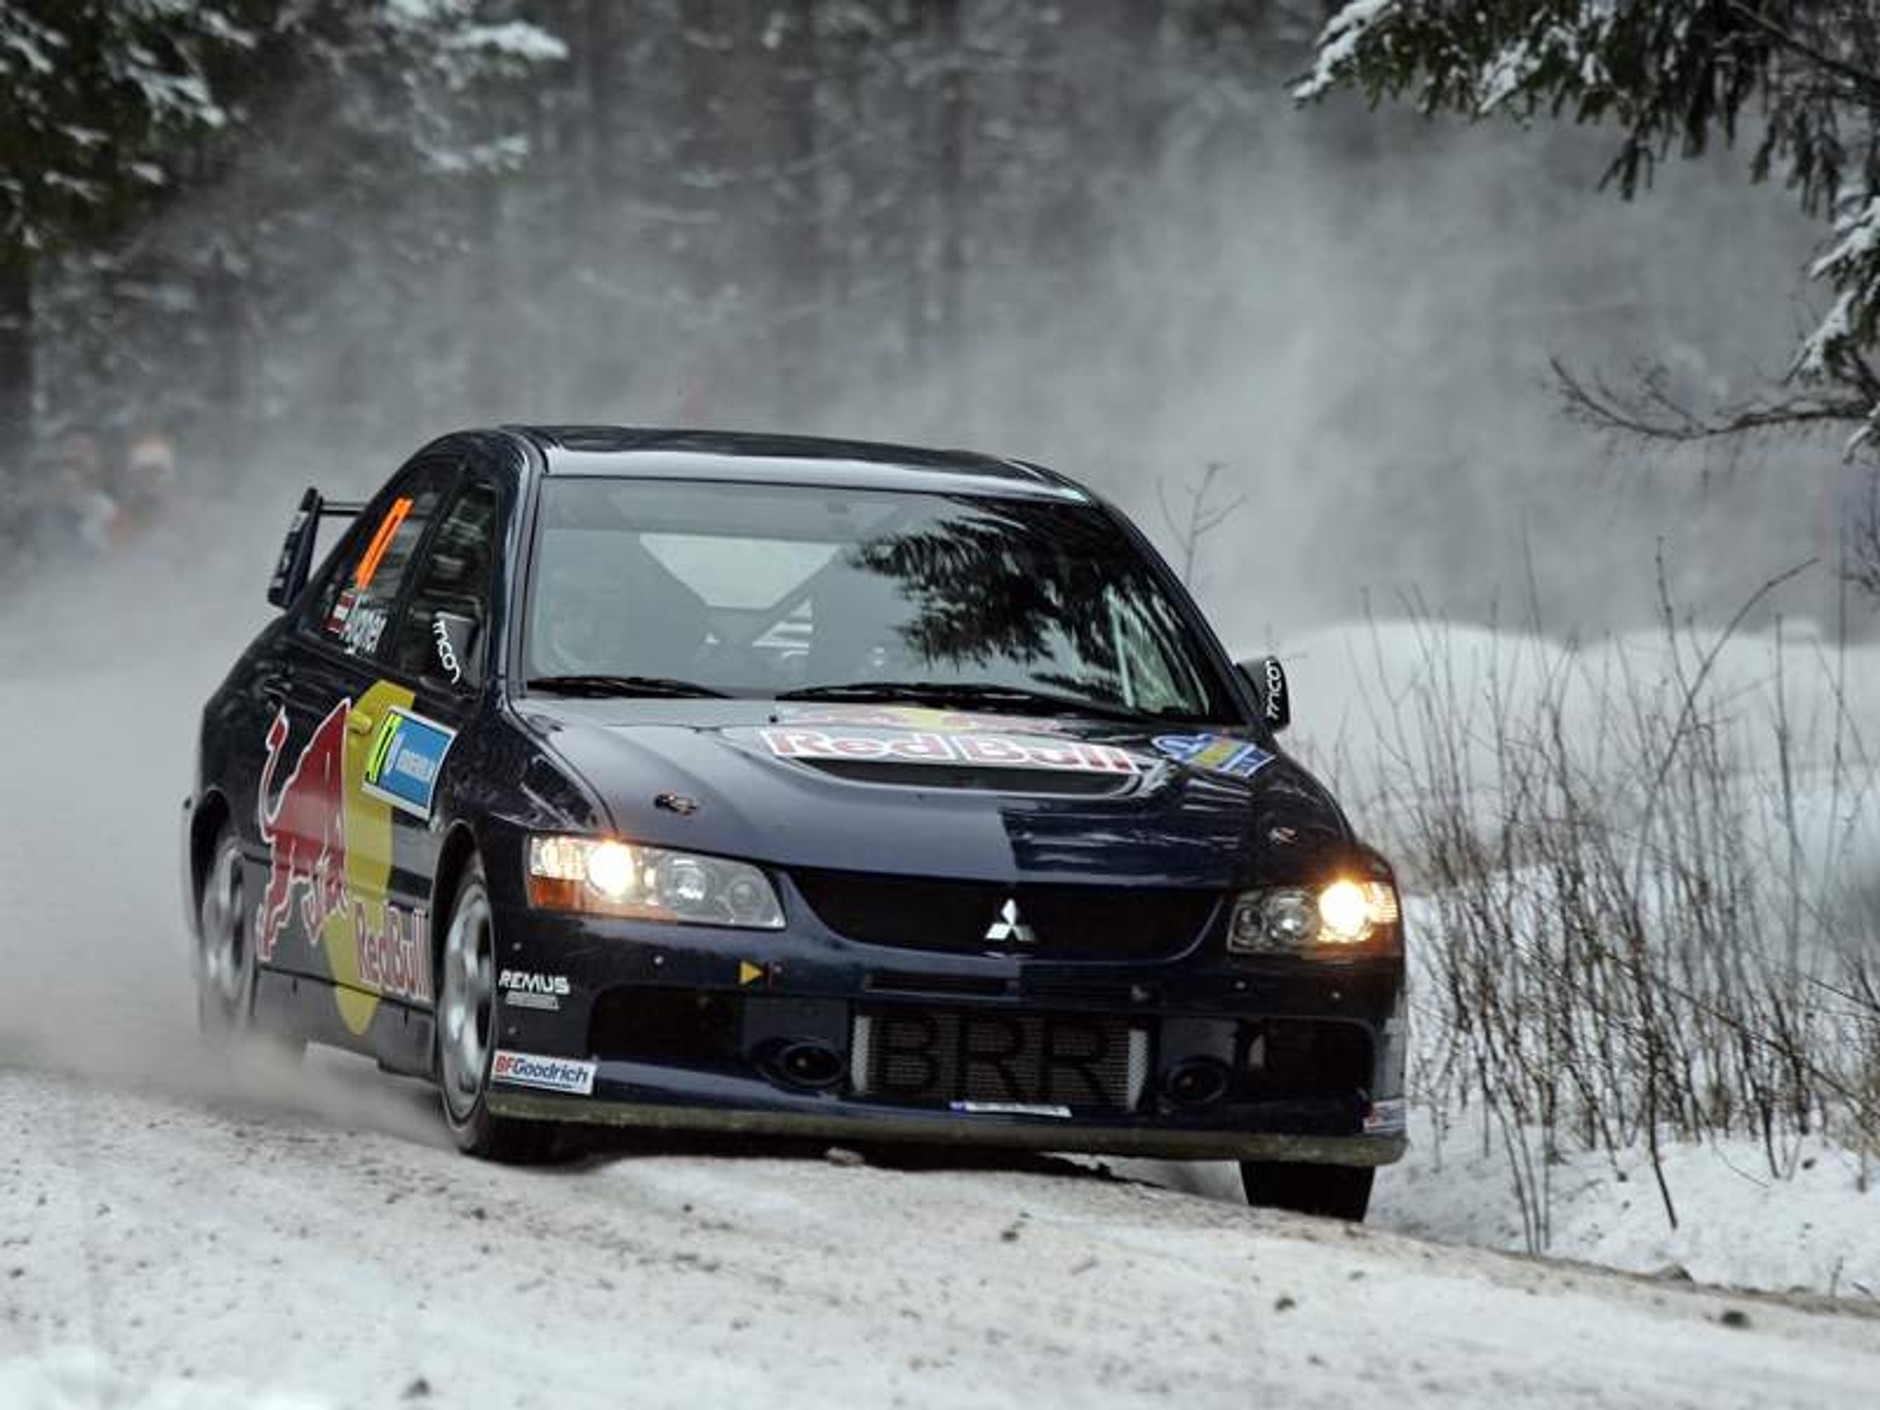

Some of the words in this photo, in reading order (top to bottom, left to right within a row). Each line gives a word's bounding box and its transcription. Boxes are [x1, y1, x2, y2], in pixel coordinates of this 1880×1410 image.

[762, 727, 957, 760] Red
[950, 735, 1142, 774] Bull
[499, 969, 570, 995] REMUS
[495, 1054, 589, 1083] BFGoodrich
[877, 1008, 1112, 1104] BRR
